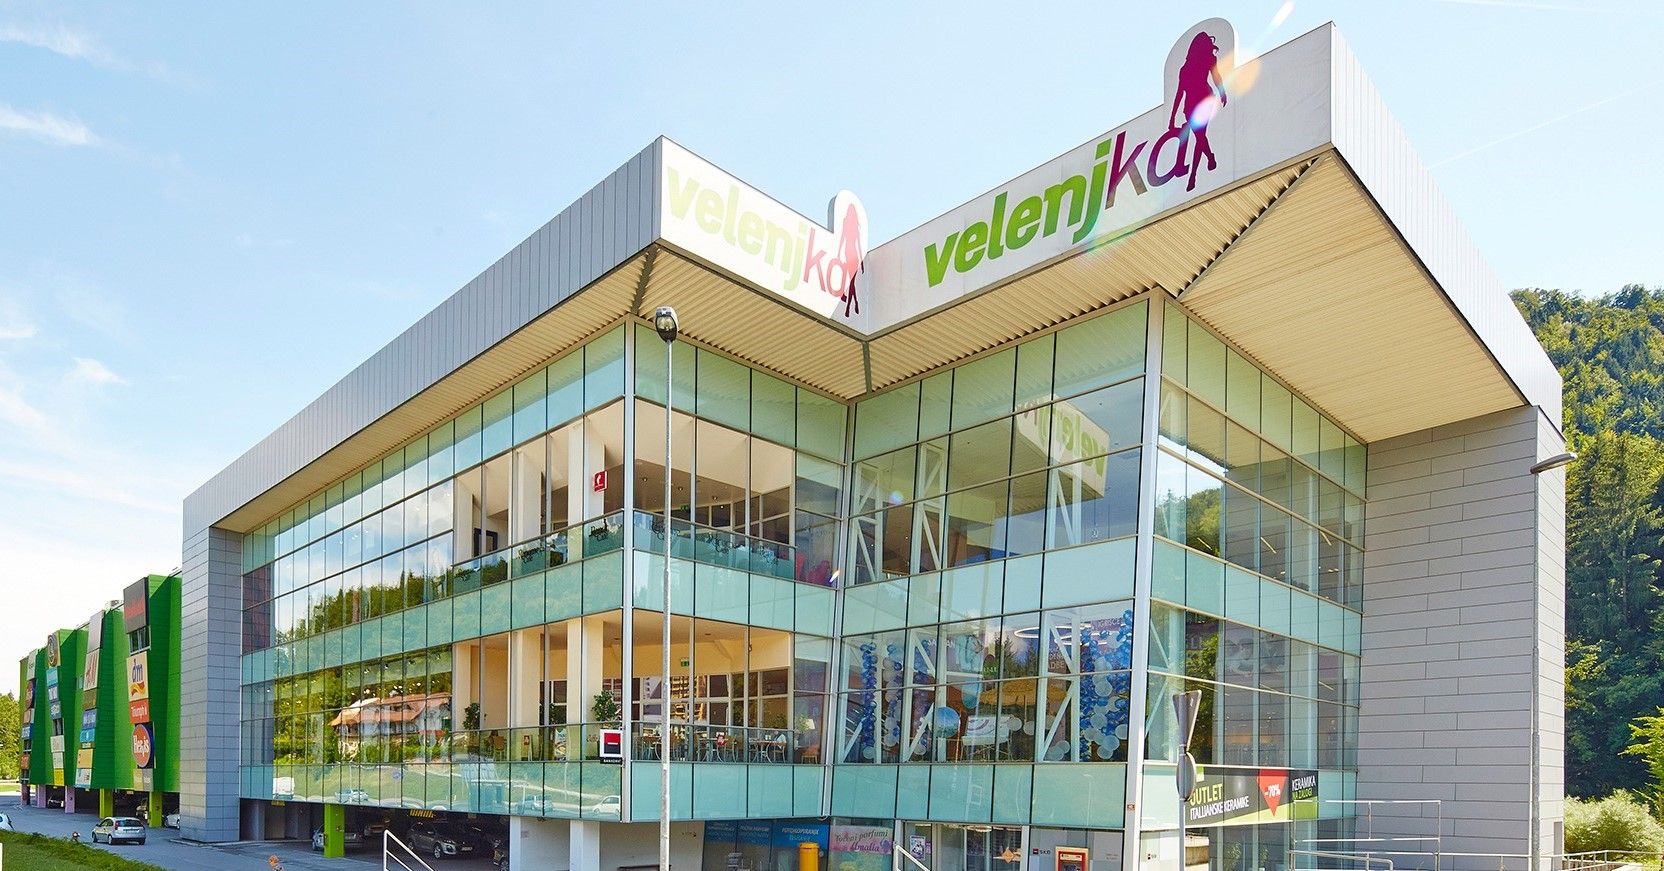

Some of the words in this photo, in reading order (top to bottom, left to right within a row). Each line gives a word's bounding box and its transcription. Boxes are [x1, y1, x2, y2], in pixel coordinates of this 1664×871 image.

[666, 166, 848, 304] velenjka
[924, 127, 1191, 289] velenjka
[132, 658, 144, 682] dm
